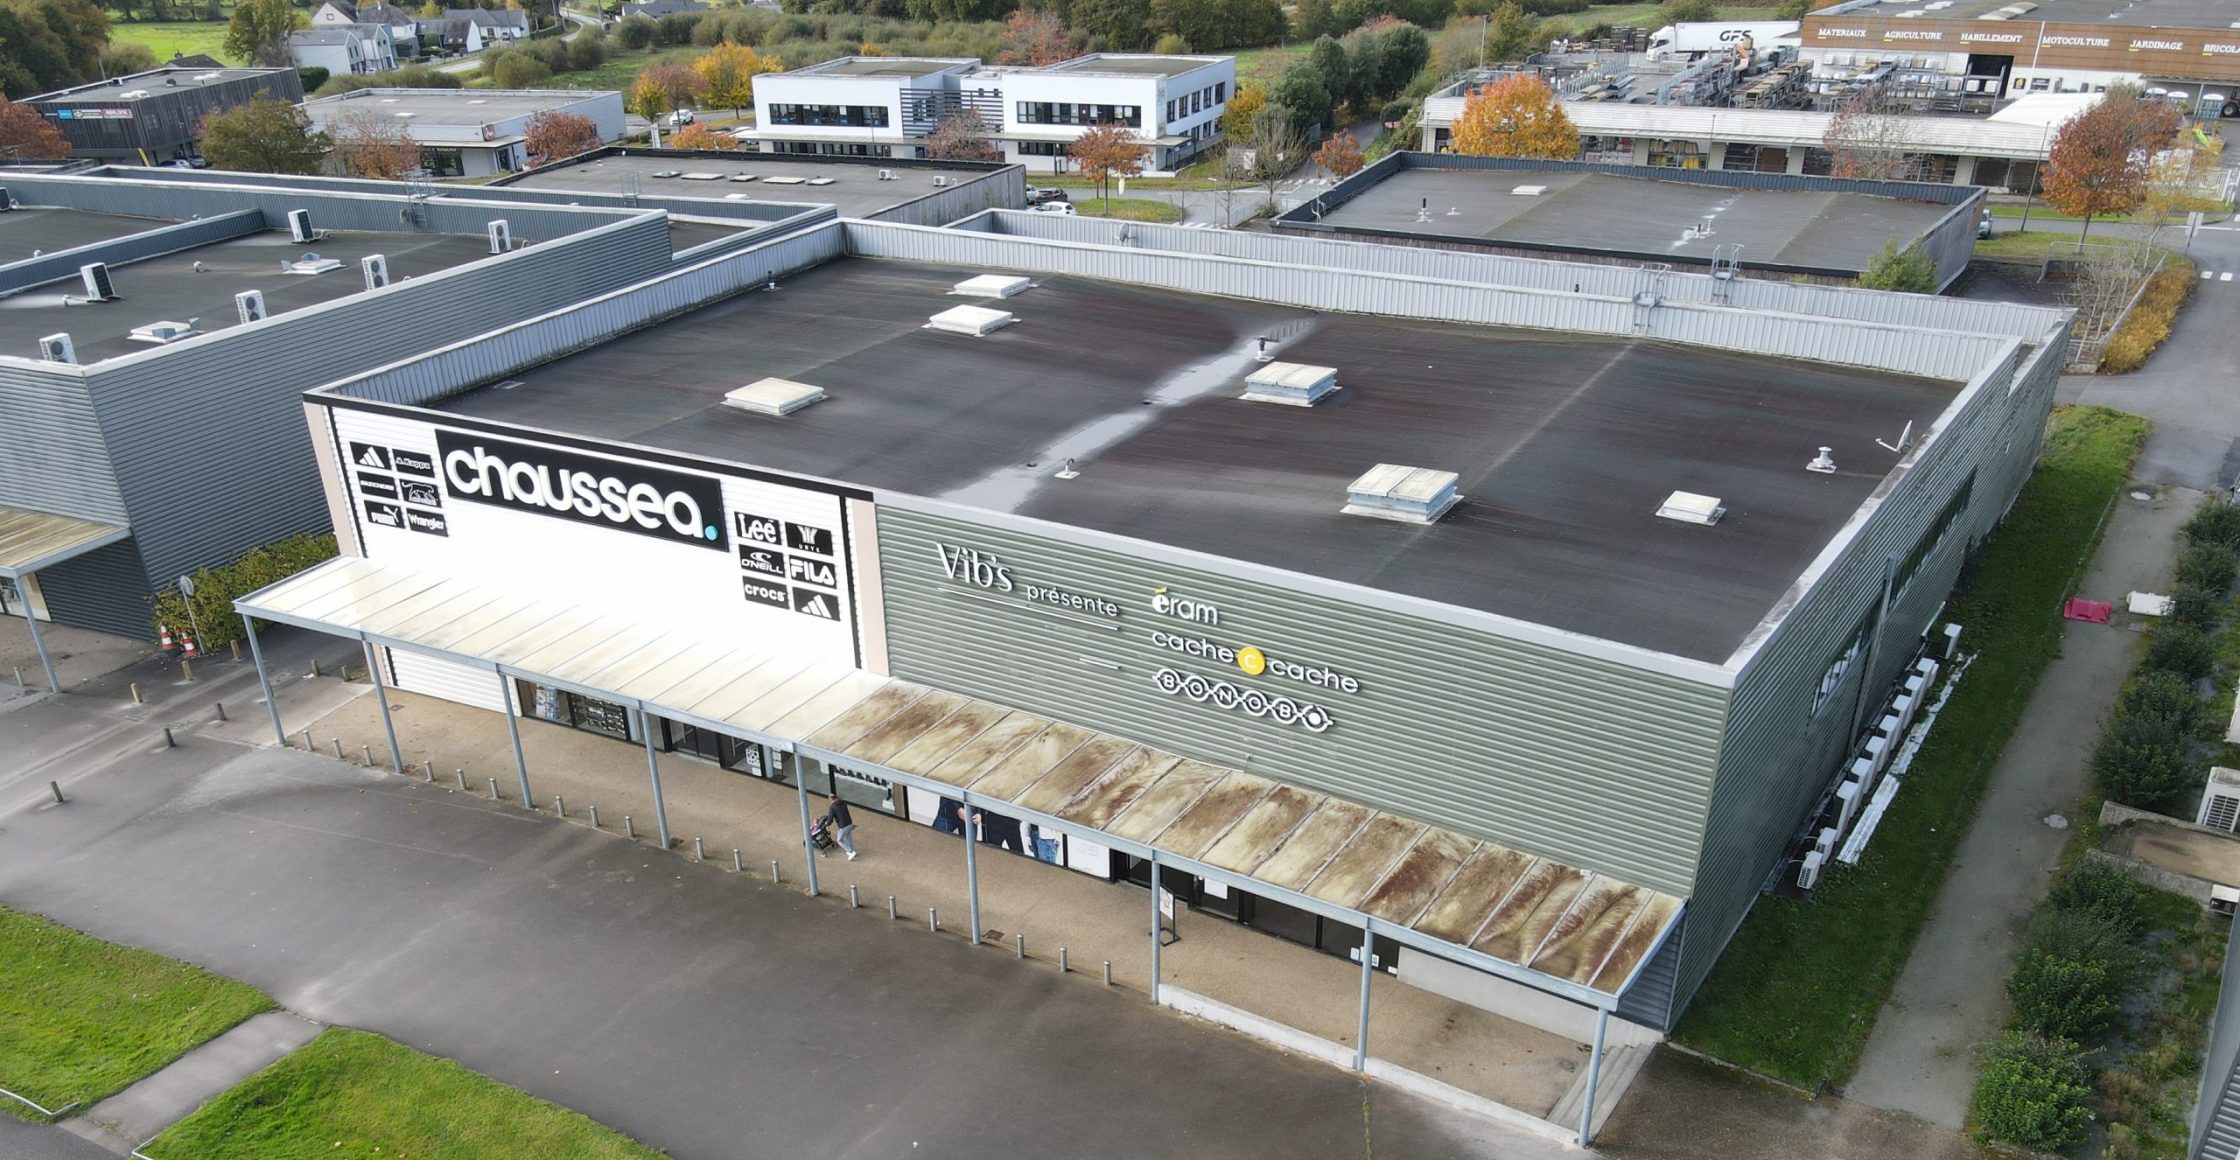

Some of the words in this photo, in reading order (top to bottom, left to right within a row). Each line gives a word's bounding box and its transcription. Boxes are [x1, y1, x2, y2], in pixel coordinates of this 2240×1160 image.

[1719, 30, 1752, 41] GFS
[1818, 28, 1867, 38] MATERIAUX
[1884, 31, 1943, 40] AGRICULTURE
[1960, 33, 2023, 43] HABILLEMENT
[2042, 35, 2110, 47] MOTOCULTURE
[2130, 40, 2183, 50] JARDINAGE
[408, 513, 445, 530] Wrangler
[738, 513, 777, 543] Lee
[790, 558, 835, 586] FILA
[935, 542, 1014, 593] Vib's
[1026, 584, 1119, 617] présente
[744, 584, 785, 602] crocs
[1151, 631, 1235, 664] cache
[1269, 658, 1360, 694] cache
[1158, 672, 1328, 729] BONOBO
